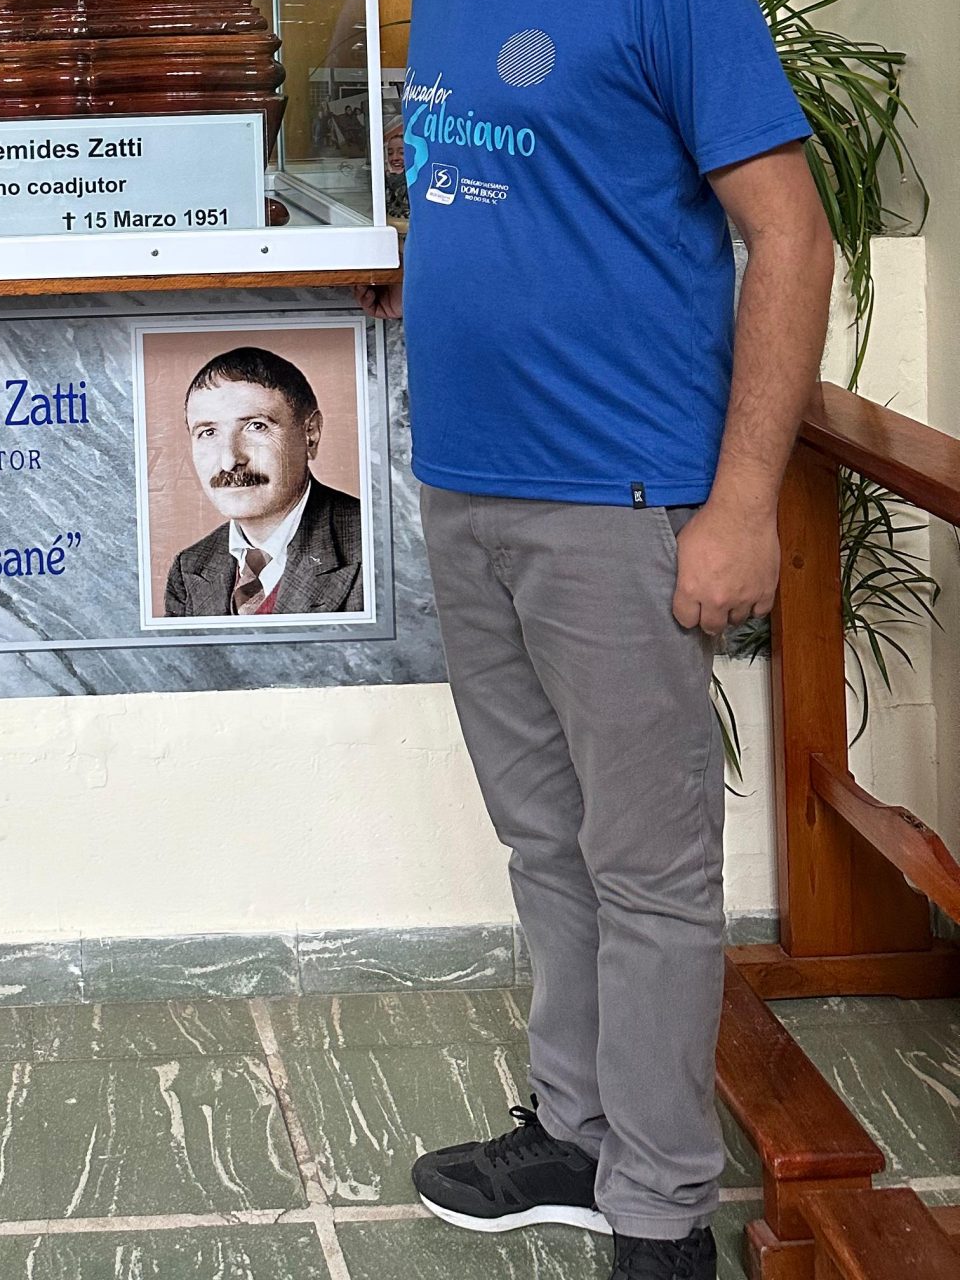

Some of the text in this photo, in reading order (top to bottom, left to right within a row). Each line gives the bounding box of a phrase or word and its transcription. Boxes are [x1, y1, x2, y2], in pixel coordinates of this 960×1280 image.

[87, 137, 142, 158] Zatti
[403, 101, 535, 188] Salesiano
[27, 176, 127, 198] coadjutor
[460, 185, 507, 200] DOM BOSCO
[83, 208, 228, 229] 15 Marzo 1951
[4, 379, 90, 426] Zatti
